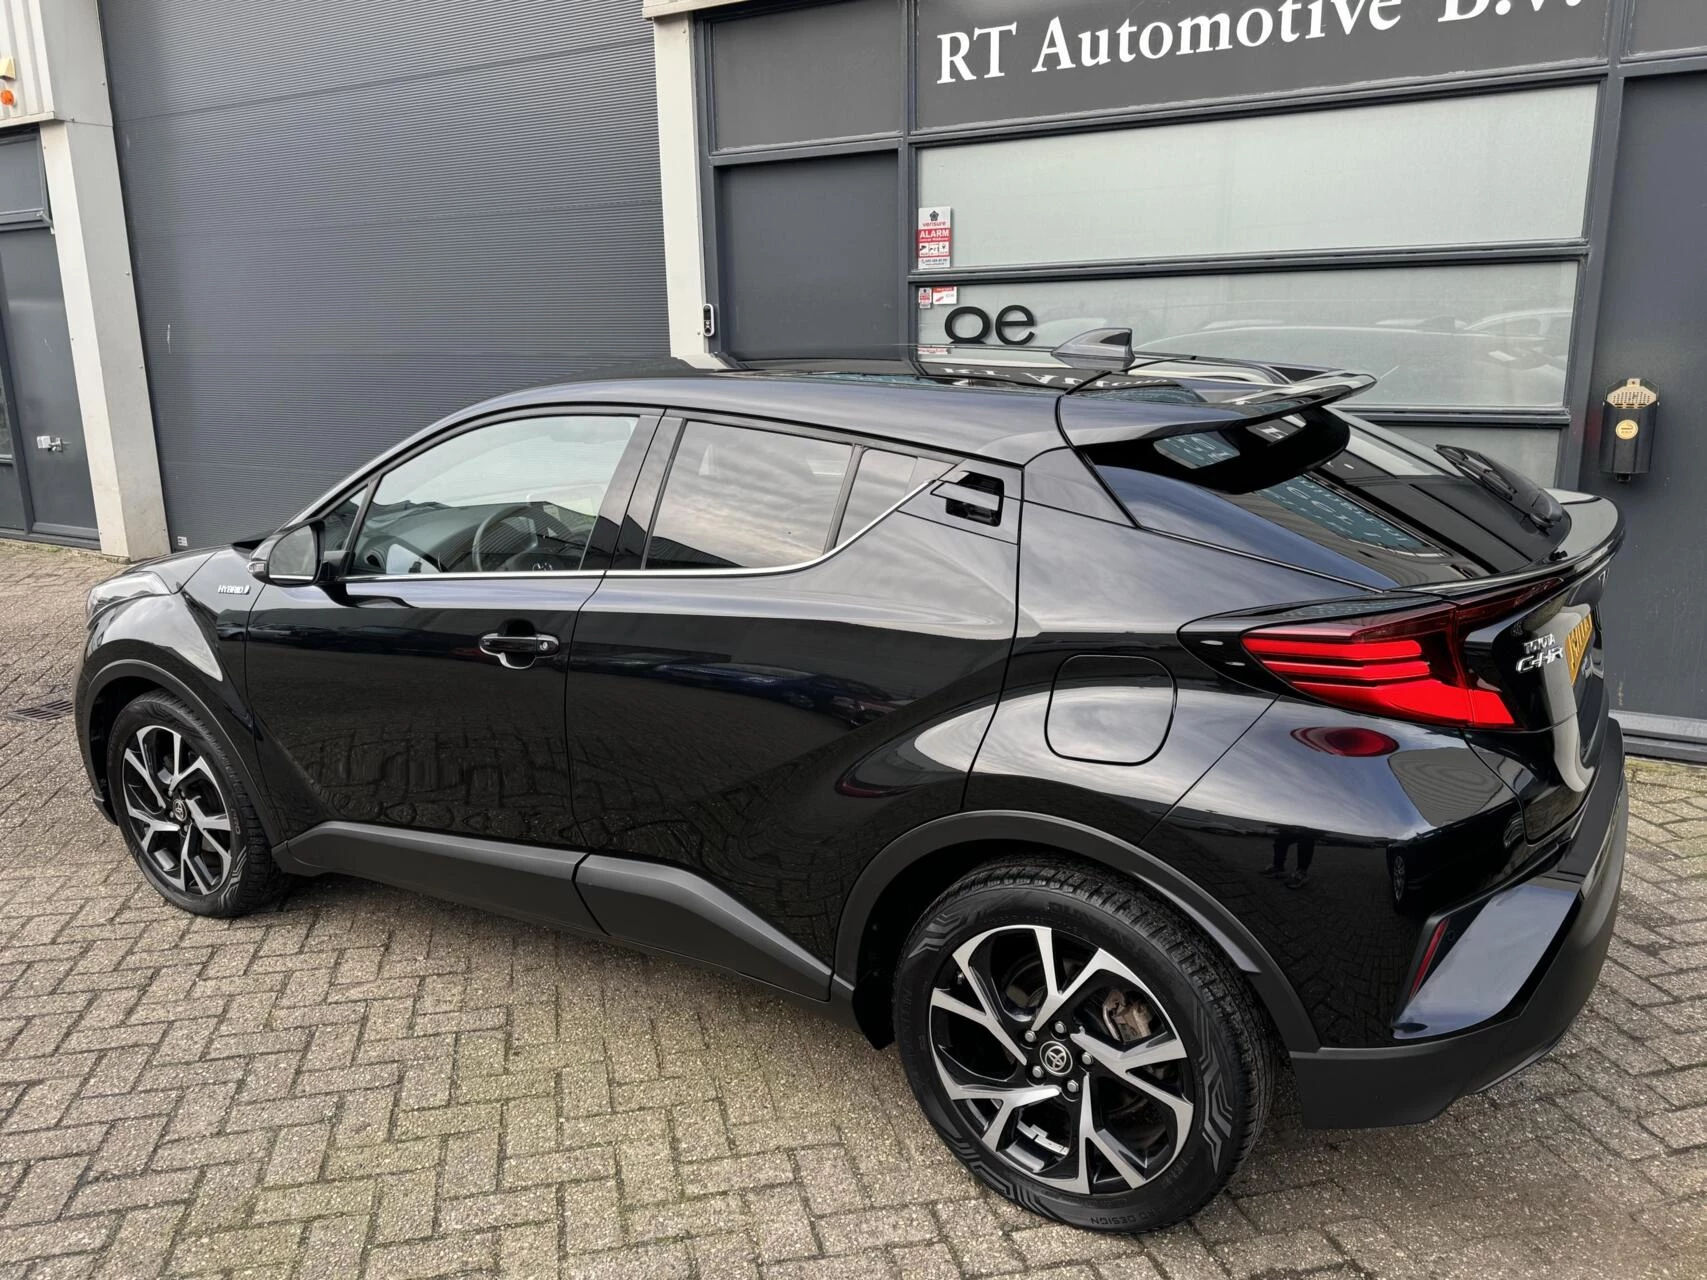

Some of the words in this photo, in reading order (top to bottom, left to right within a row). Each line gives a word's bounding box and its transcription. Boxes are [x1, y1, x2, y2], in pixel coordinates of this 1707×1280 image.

[937, 22, 1017, 84] RT
[1032, 0, 1401, 72] Automotive
[920, 229, 949, 237] ALARM
[218, 585, 244, 594] HYBRID
